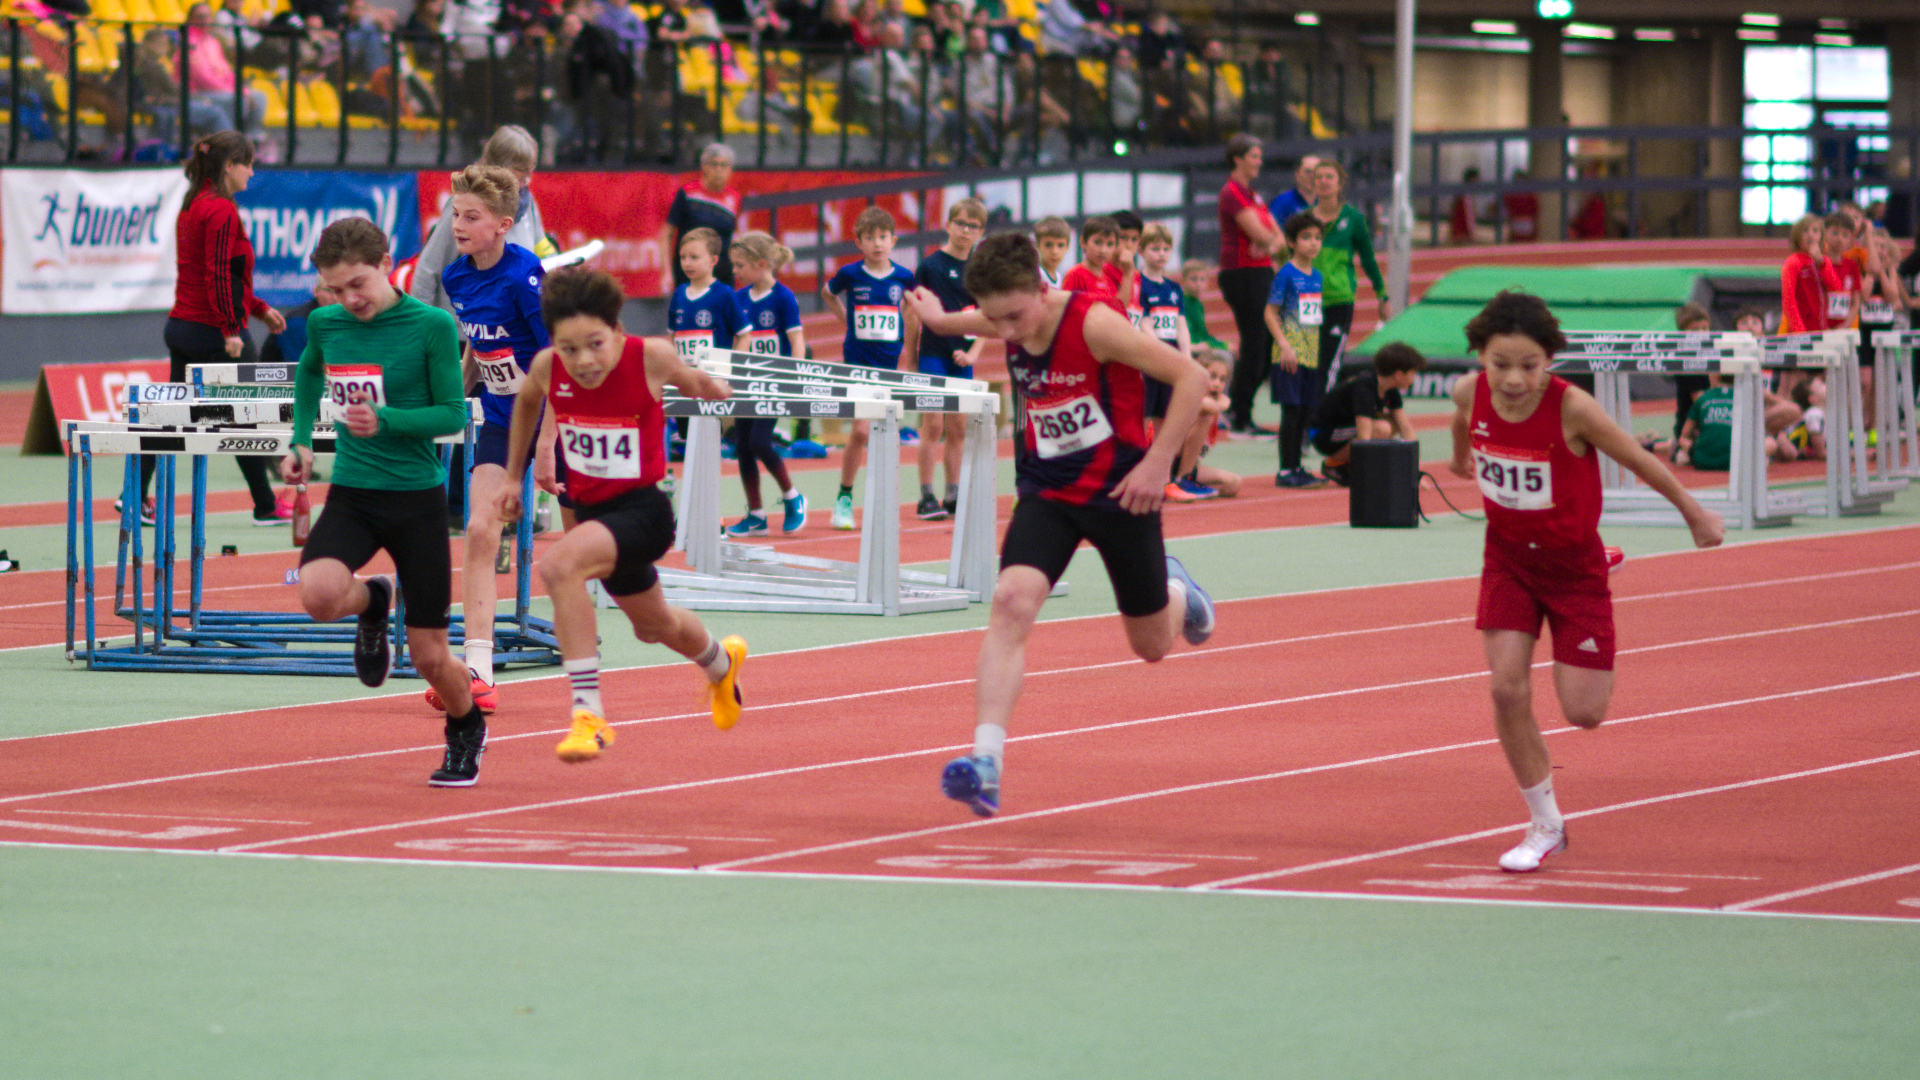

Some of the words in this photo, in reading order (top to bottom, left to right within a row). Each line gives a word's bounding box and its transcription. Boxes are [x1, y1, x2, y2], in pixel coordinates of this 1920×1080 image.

[70, 192, 162, 246] bunert
[858, 314, 895, 330] 3178
[1588, 359, 1620, 372] WGV
[144, 385, 188, 401] GfTD
[216, 386, 254, 398] Indoor
[256, 386, 296, 398] Meetin
[698, 402, 736, 415] WGV
[755, 402, 791, 415] GLS.
[1034, 402, 1098, 439] 2682
[218, 438, 279, 450] SPORTCO
[565, 429, 632, 460] 2914
[1478, 456, 1543, 493] 2915
